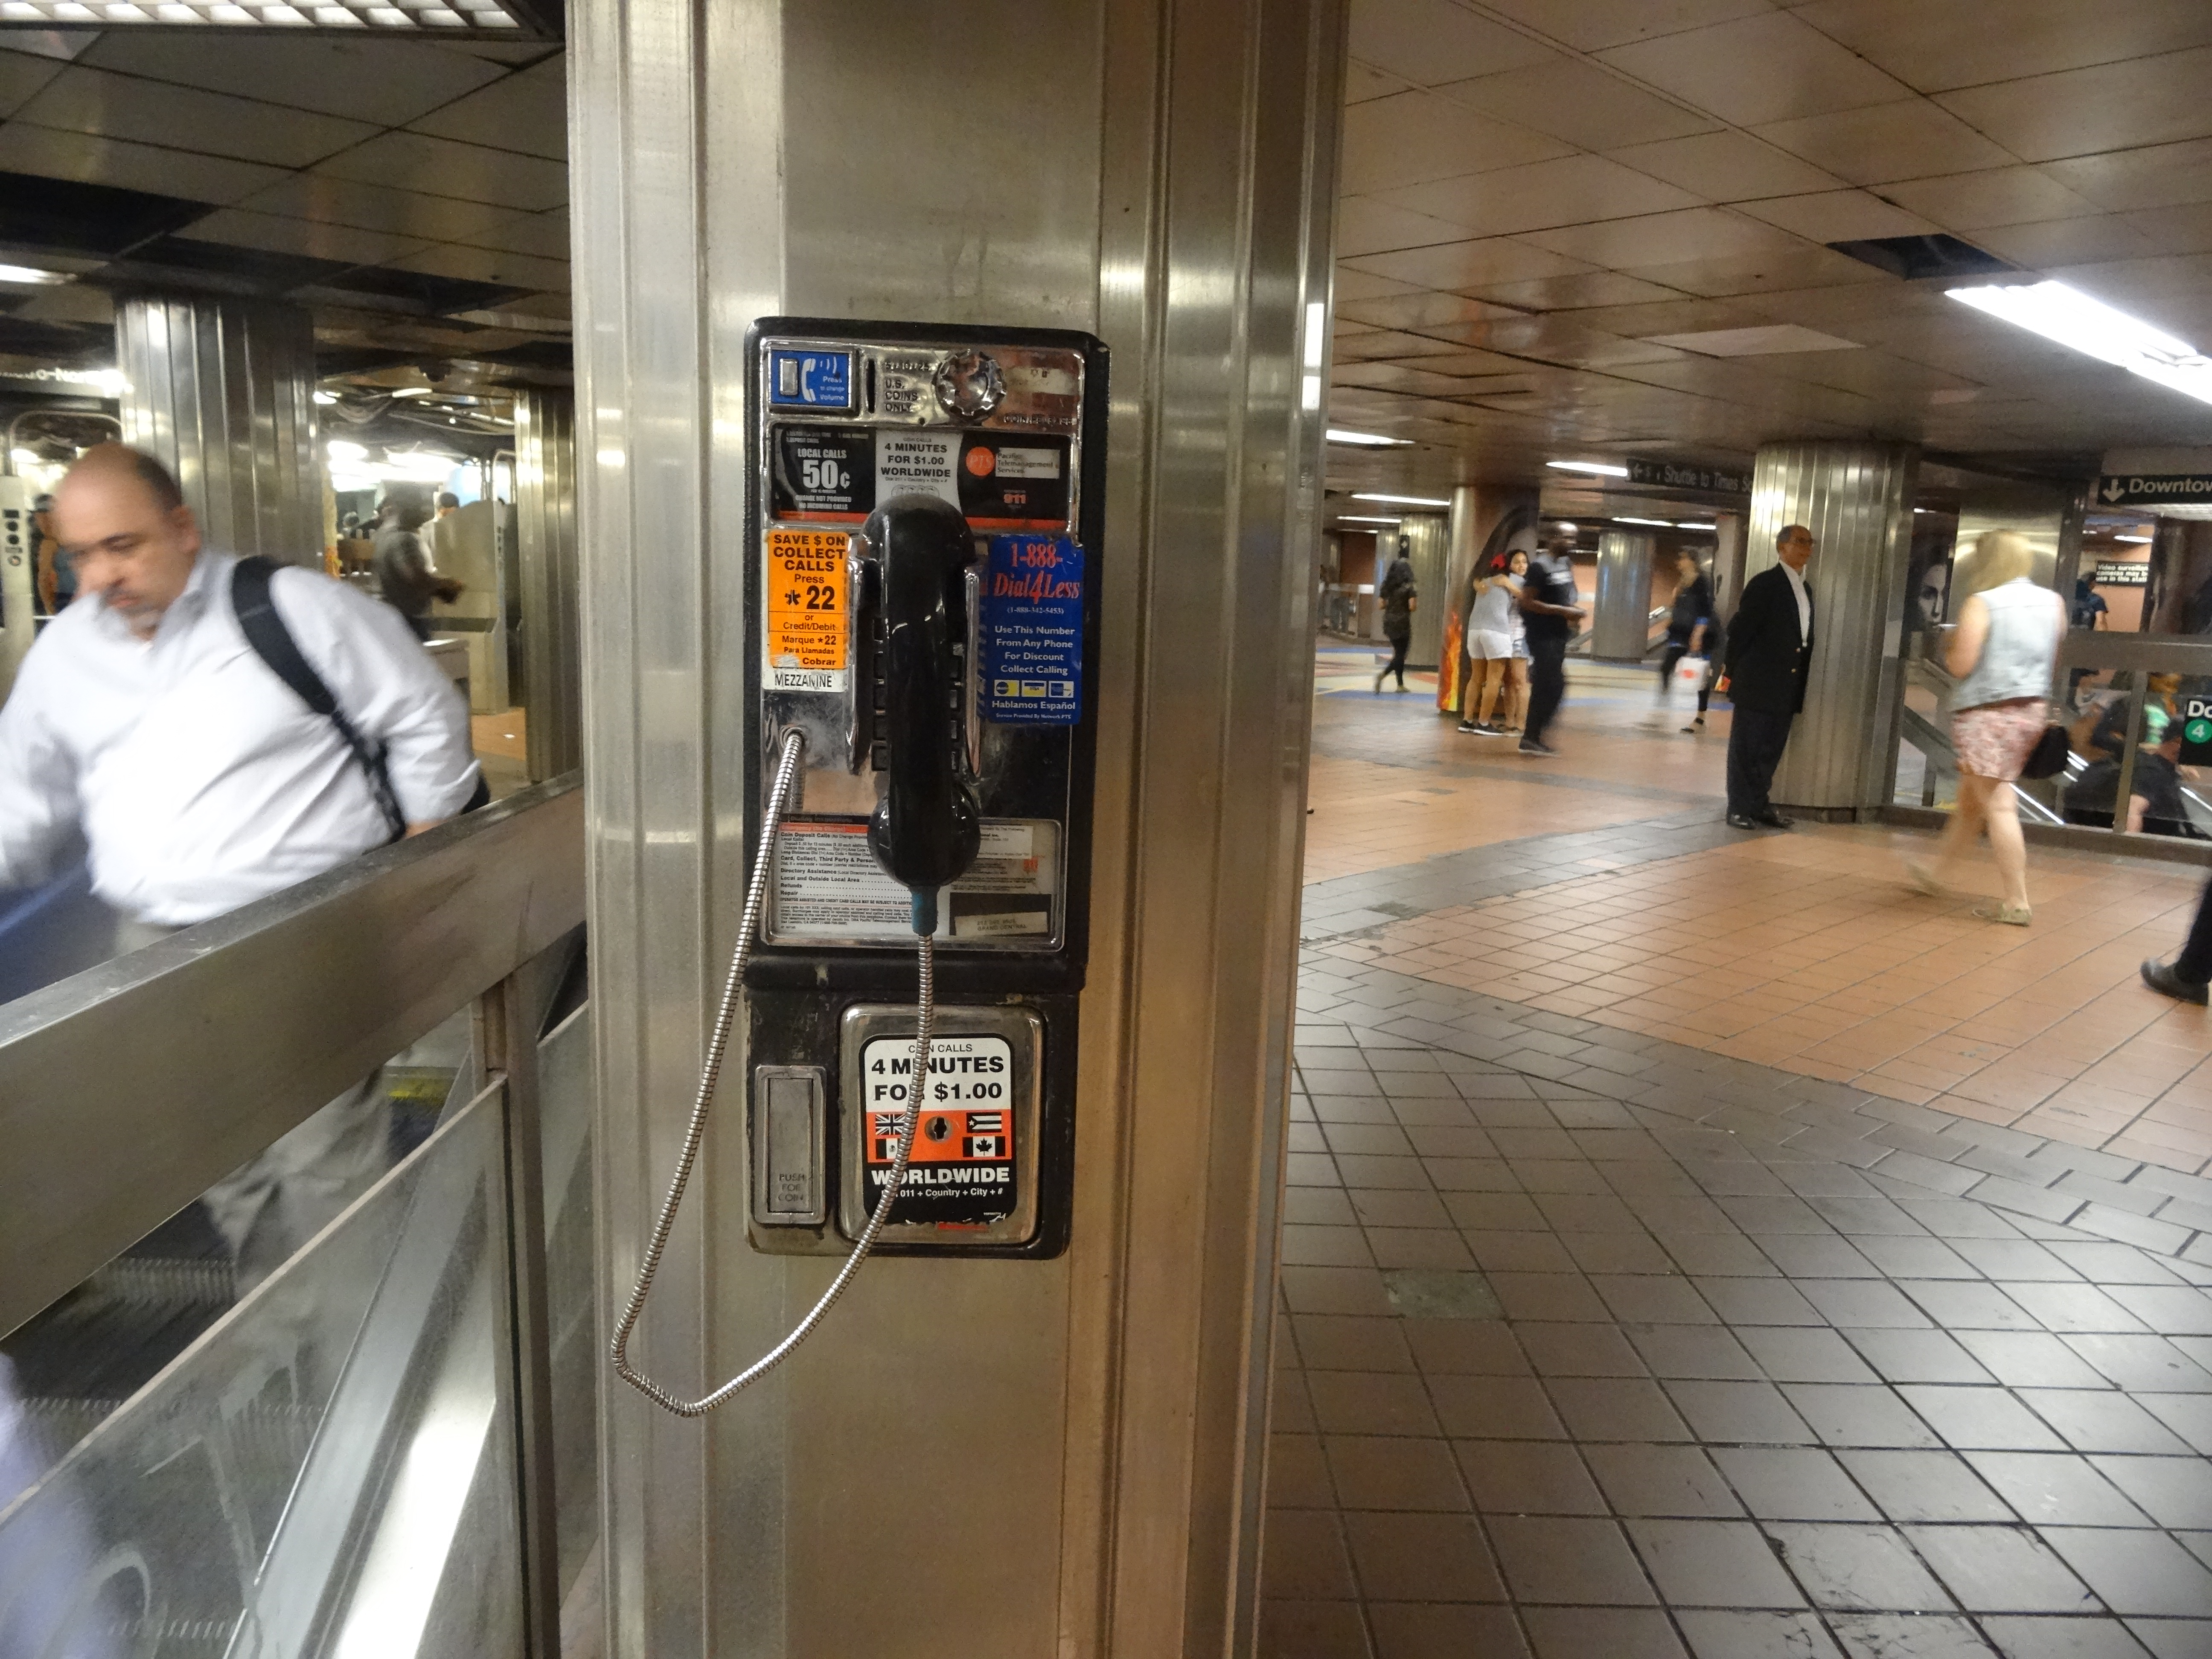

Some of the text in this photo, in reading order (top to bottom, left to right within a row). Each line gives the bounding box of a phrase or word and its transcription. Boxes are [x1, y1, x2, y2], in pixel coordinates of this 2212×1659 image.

[885, 378, 905, 389] U.S.
[885, 391, 917, 401] COINS
[797, 448, 847, 459] LOCAL CALLS
[895, 443, 947, 453] MINUTES
[888, 455, 944, 465] FOR $1.00
[881, 467, 951, 477] WORLDWIDE
[1004, 493, 1026, 504] 911
[774, 535, 845, 546] SAVE $ ON
[774, 547, 846, 559] COLLECT
[1011, 543, 1063, 568] 1-888-
[784, 560, 835, 572] CALLS
[795, 573, 824, 584] Press
[993, 570, 1080, 604] Dial4Less
[783, 622, 835, 631] Credit/Debit
[1013, 626, 1033, 634] This
[1036, 626, 1075, 635] Number
[782, 635, 814, 645] Marque
[996, 638, 1073, 649] From Any Phone
[803, 658, 836, 666] Cobrar
[1023, 652, 1064, 661] Discount
[1001, 665, 1068, 676] Collect Calling
[774, 674, 832, 687] MEZZANINE
[992, 701, 1075, 710] Hablamos Español
[2192, 724, 2205, 738] 4
[908, 1044, 972, 1054] CN CALLS
[872, 1059, 885, 1074] 4
[875, 1082, 1002, 1102] FO $1.00
[779, 1173, 805, 1182] PUSH
[782, 1183, 801, 1192] FOR
[900, 1189, 914, 1198] 011
[926, 1188, 960, 1199] Country
[971, 1187, 987, 1197] City
[778, 1193, 803, 1202] COIN
